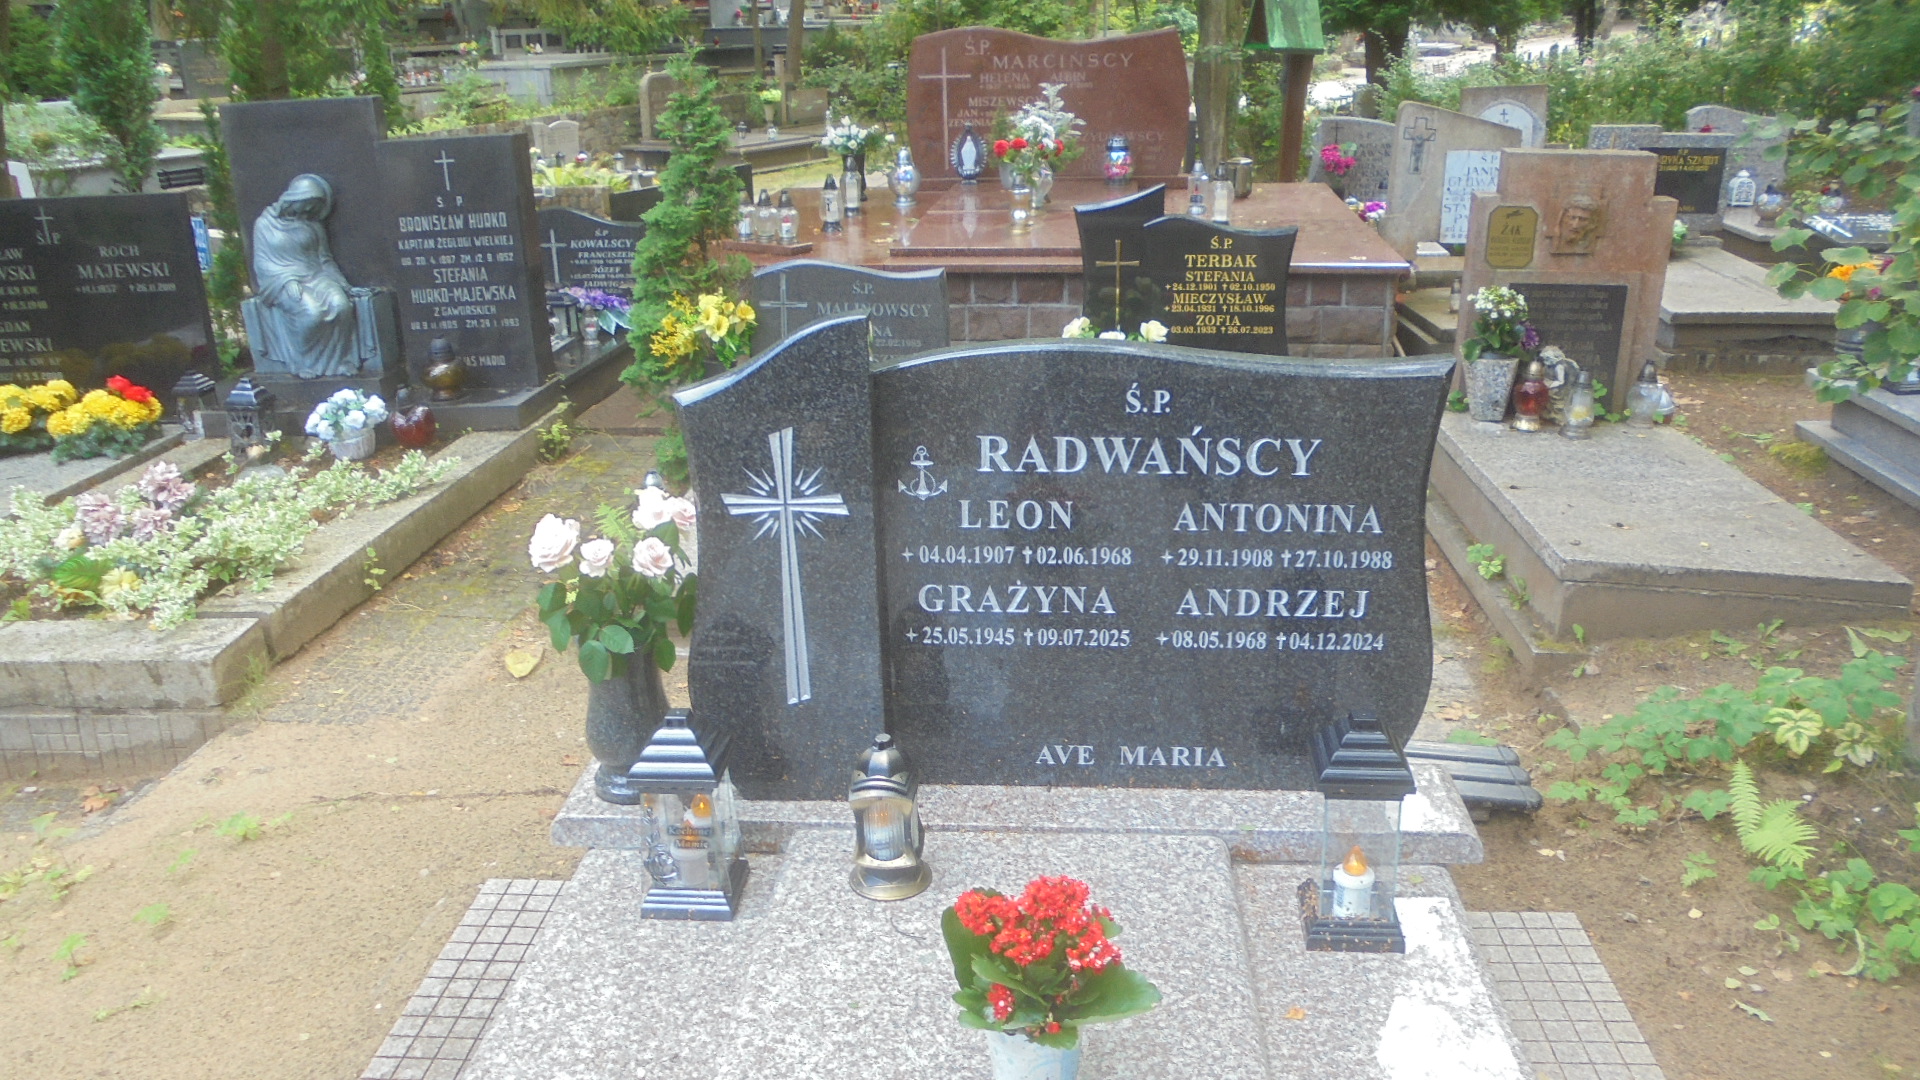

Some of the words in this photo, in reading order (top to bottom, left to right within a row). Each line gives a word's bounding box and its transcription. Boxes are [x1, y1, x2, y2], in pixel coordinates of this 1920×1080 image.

[980, 72, 1029, 83] HELENA
[399, 214, 464, 232] BRONISŁAW
[468, 211, 508, 229] HURKO
[398, 239, 435, 250] KAPITAN
[474, 235, 514, 247] WIELKIEJ
[570, 239, 633, 249] KOWALSCY
[98, 244, 140, 257] ROCH
[1184, 254, 1258, 268] TERBAK
[77, 262, 170, 279] MAJEWSKI
[433, 266, 488, 283] STEFANIA
[1185, 270, 1255, 282] STEFANIA
[411, 285, 516, 304] HURKO-MAJEWSKA
[1172, 283, 1217, 291] 24.12.1901
[1172, 293, 1267, 304] MIECZYSŁAW
[433, 306, 440, 317] Z
[441, 305, 497, 316] GAWORSKICH
[1196, 314, 1241, 326] ZOFIA
[1170, 326, 1216, 334] 03.03.1933
[1227, 326, 1274, 334] 26.07.2023
[976, 425, 1322, 476] RADWAŃSCY
[959, 499, 1073, 529] LEON
[1173, 503, 1383, 534] ANTONINA
[919, 545, 1015, 564] 04.04.1907
[1036, 546, 1132, 566] 02.06.1968
[1177, 548, 1273, 568] 29.11.1908
[1294, 550, 1392, 569] 27.10.1988
[918, 579, 1116, 615] GRAŻYNA
[1176, 588, 1370, 619] ANDRZEJ
[922, 627, 1015, 646] 25.05.1945
[1037, 628, 1131, 647] 09.07.2025
[1171, 631, 1267, 650] 08.05.1968
[1288, 632, 1385, 651] 04.12.2024
[1036, 745, 1094, 766] AVE
[1120, 746, 1226, 768] MARIA
